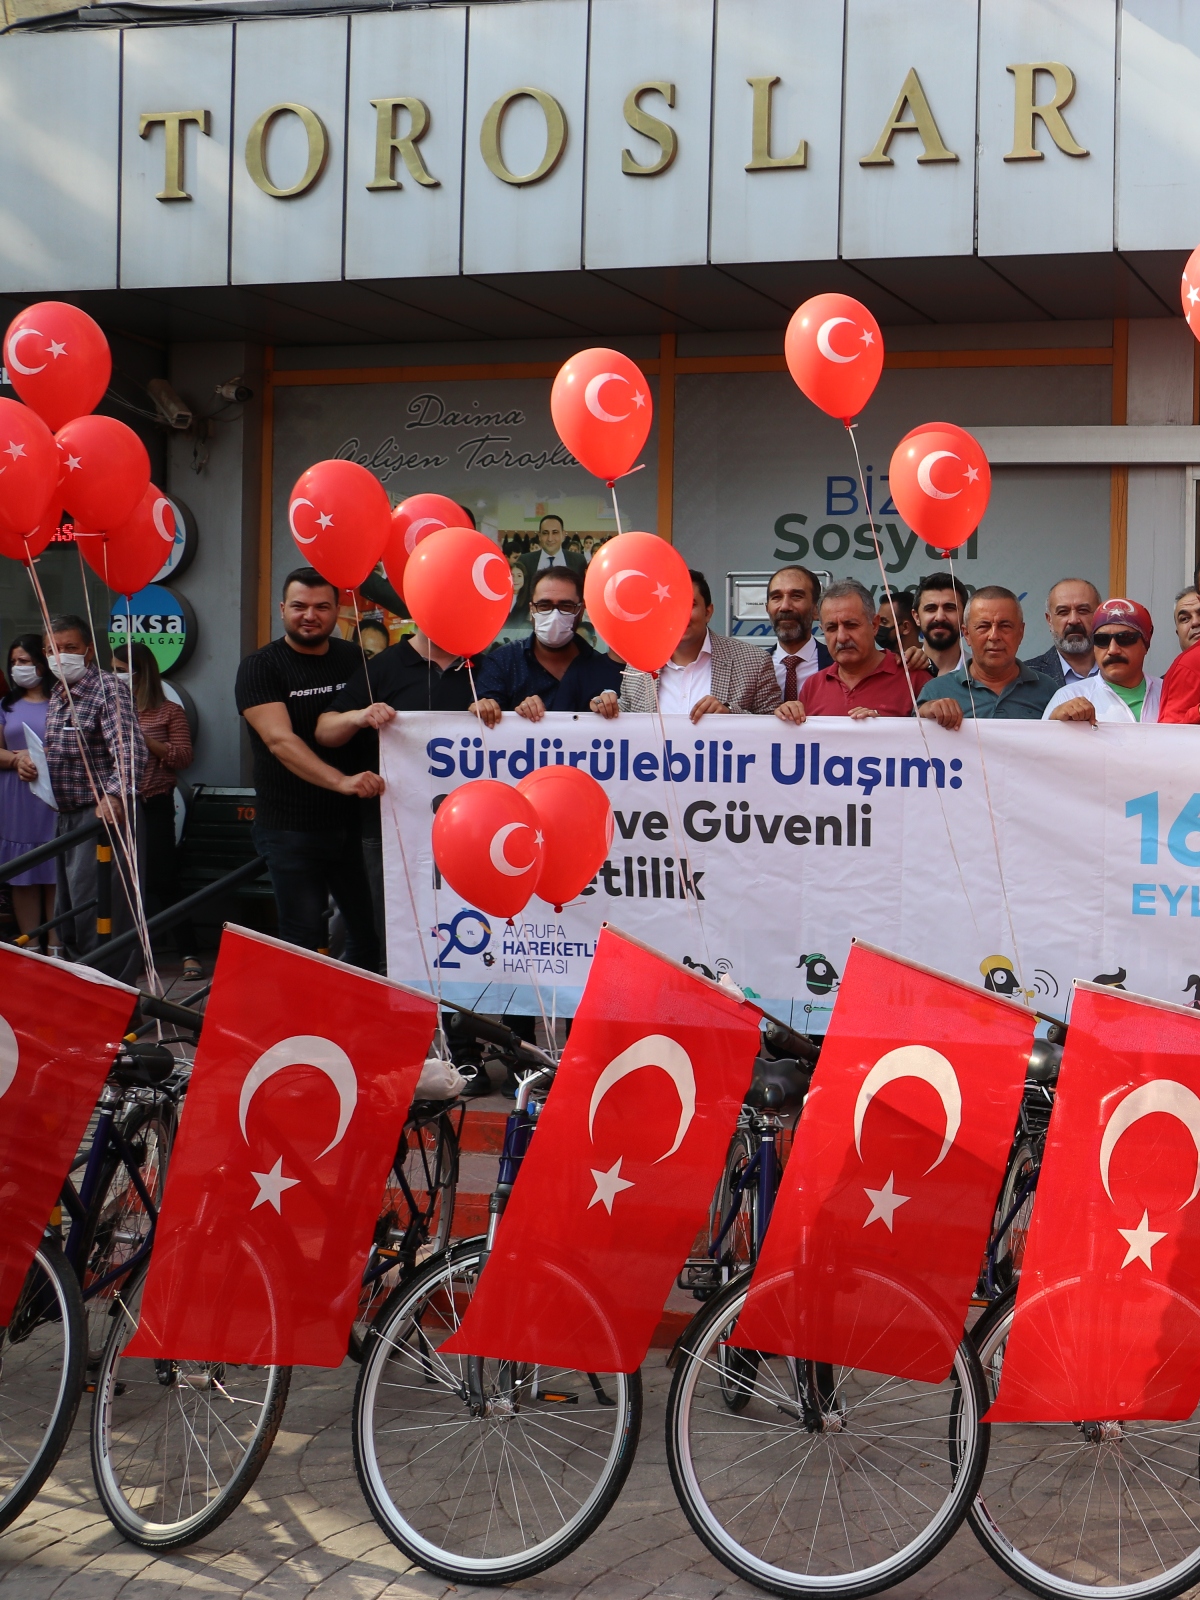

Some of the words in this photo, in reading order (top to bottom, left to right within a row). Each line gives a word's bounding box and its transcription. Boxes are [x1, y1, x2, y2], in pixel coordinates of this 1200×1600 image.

[137, 61, 1092, 202] TOROSLAR
[405, 394, 525, 429] Daima
[457, 434, 582, 470] Torosla
[825, 465, 900, 516] BİZ
[289, 686, 333, 697] POSITIVE
[427, 737, 756, 783] Sürdürülebilir
[771, 742, 963, 796] Ulaşım:
[613, 809, 669, 841] ve
[683, 799, 872, 847] Güvenli
[502, 923, 567, 939] AVRUPA
[502, 939, 598, 957] HAREKETLİ
[503, 958, 568, 974] HAFTASI
